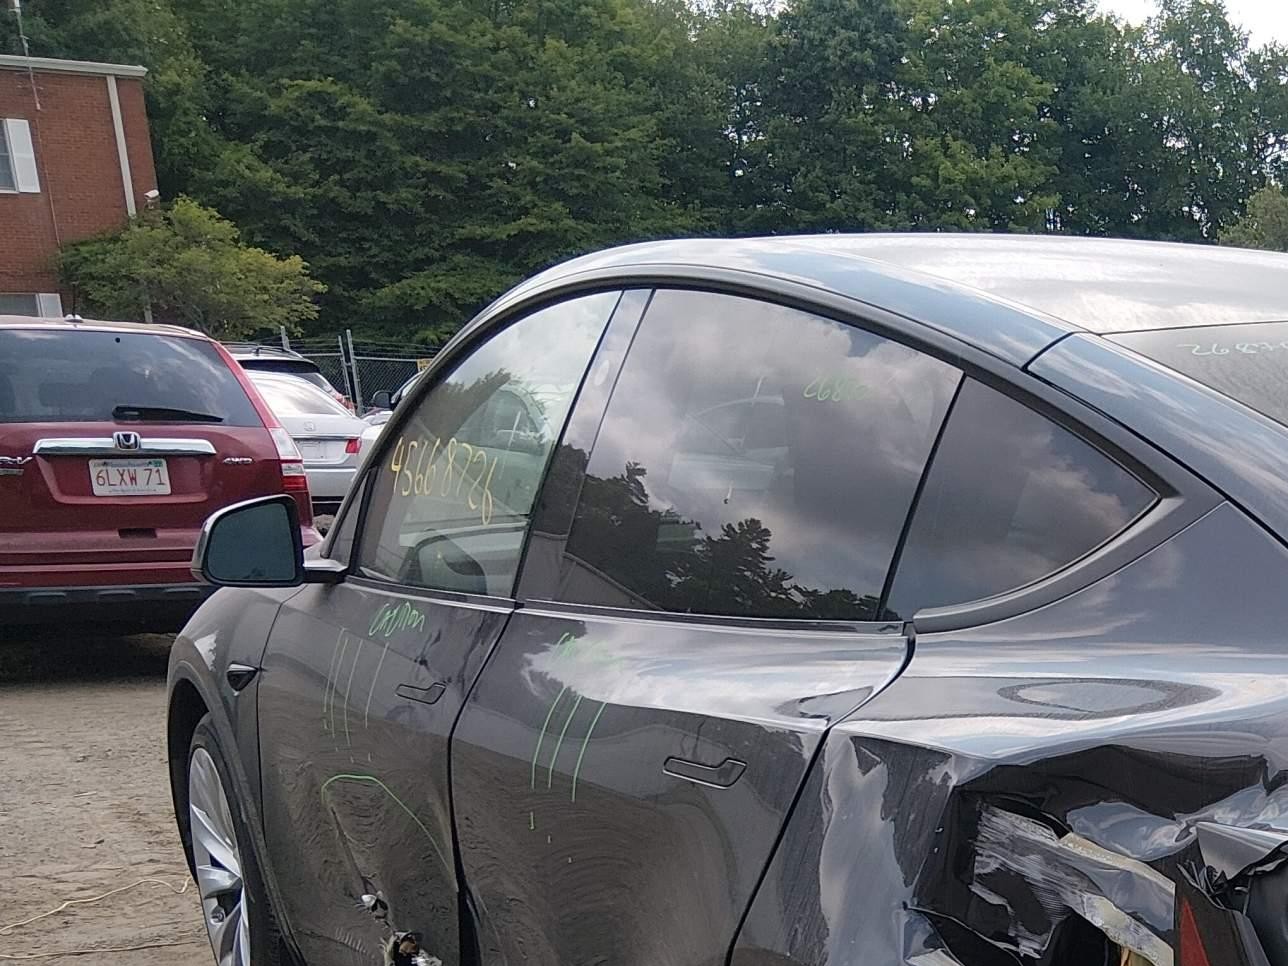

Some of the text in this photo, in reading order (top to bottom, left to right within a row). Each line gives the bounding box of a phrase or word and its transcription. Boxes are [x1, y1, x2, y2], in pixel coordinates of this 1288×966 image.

[96, 468, 166, 487] 6LXW 71
[391, 435, 498, 526] 45668726
